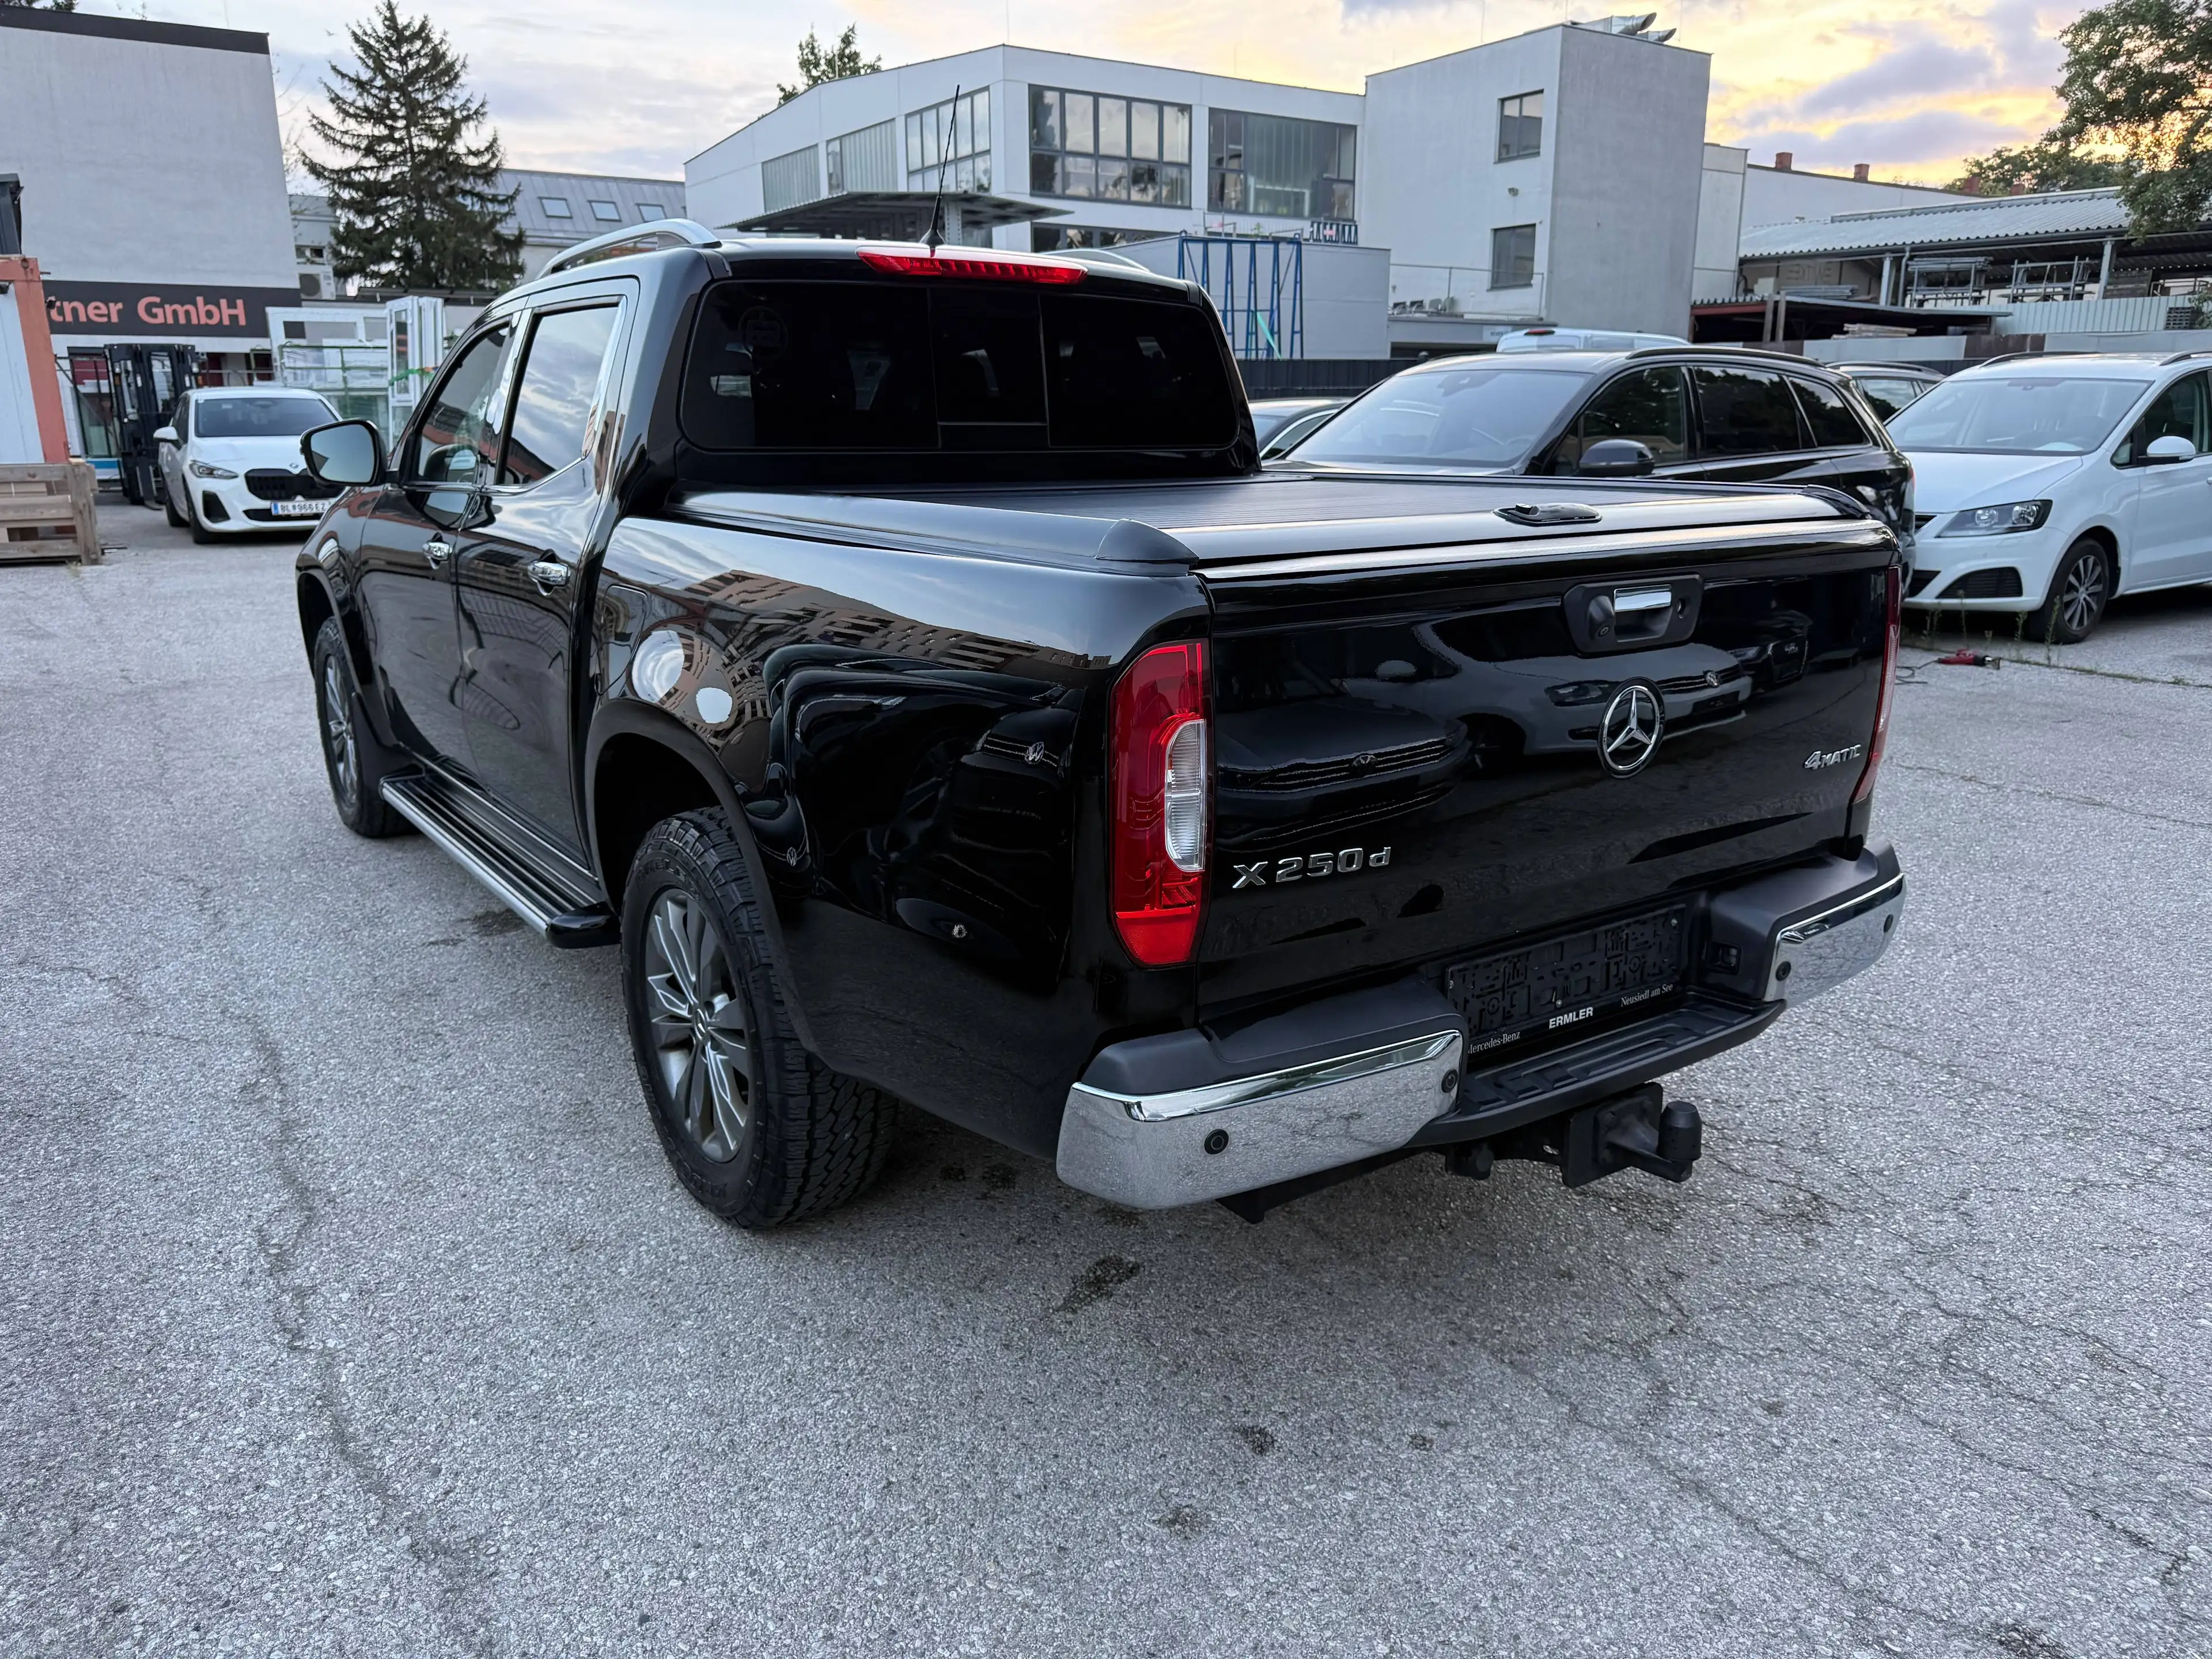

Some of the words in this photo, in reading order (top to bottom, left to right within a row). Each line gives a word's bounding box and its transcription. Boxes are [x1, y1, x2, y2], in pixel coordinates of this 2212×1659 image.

[137, 296, 246, 326] GmbH
[1804, 744, 1861, 770] 4MATIC
[1621, 989, 1649, 1007] Neusiedl
[1650, 987, 1660, 998] am
[1661, 983, 1673, 994] See
[1549, 1006, 1593, 1029] ERMLER
